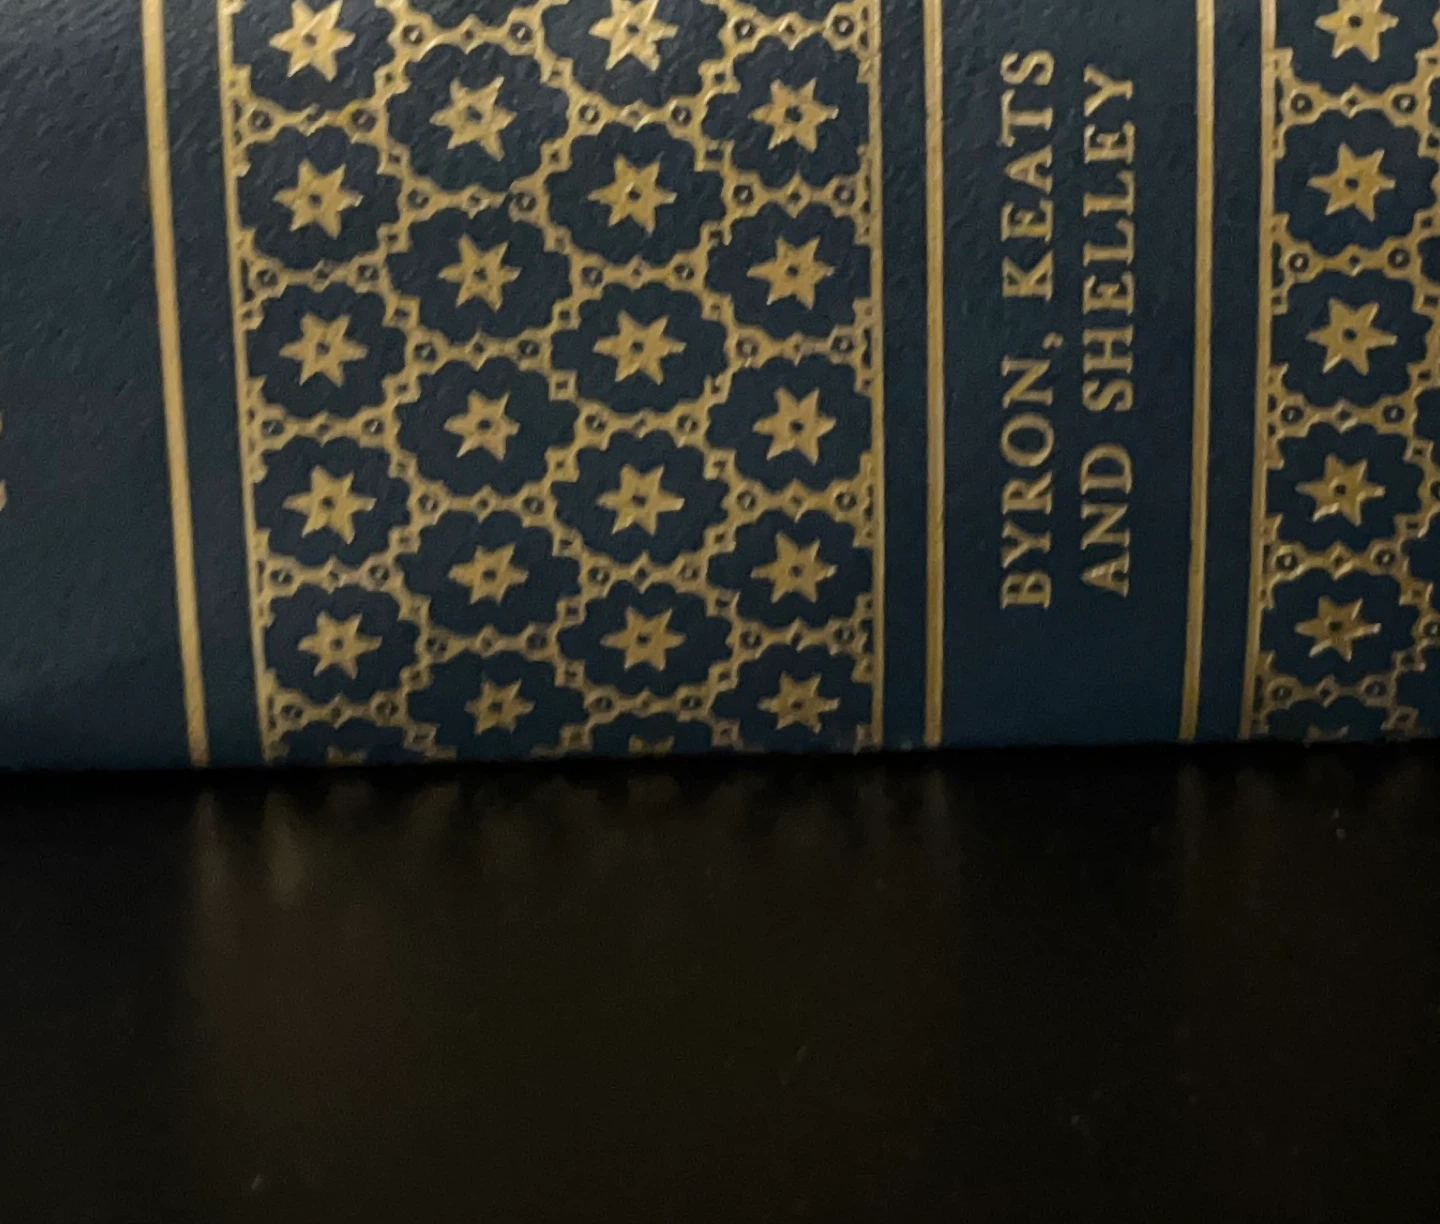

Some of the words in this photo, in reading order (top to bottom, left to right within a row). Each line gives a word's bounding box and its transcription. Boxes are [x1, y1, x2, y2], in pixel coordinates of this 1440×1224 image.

[998, 48, 1056, 302] KEATS
[1082, 62, 1138, 413] SHELLEY
[998, 331, 1065, 611] BYRON,
[1079, 443, 1134, 599] AND
